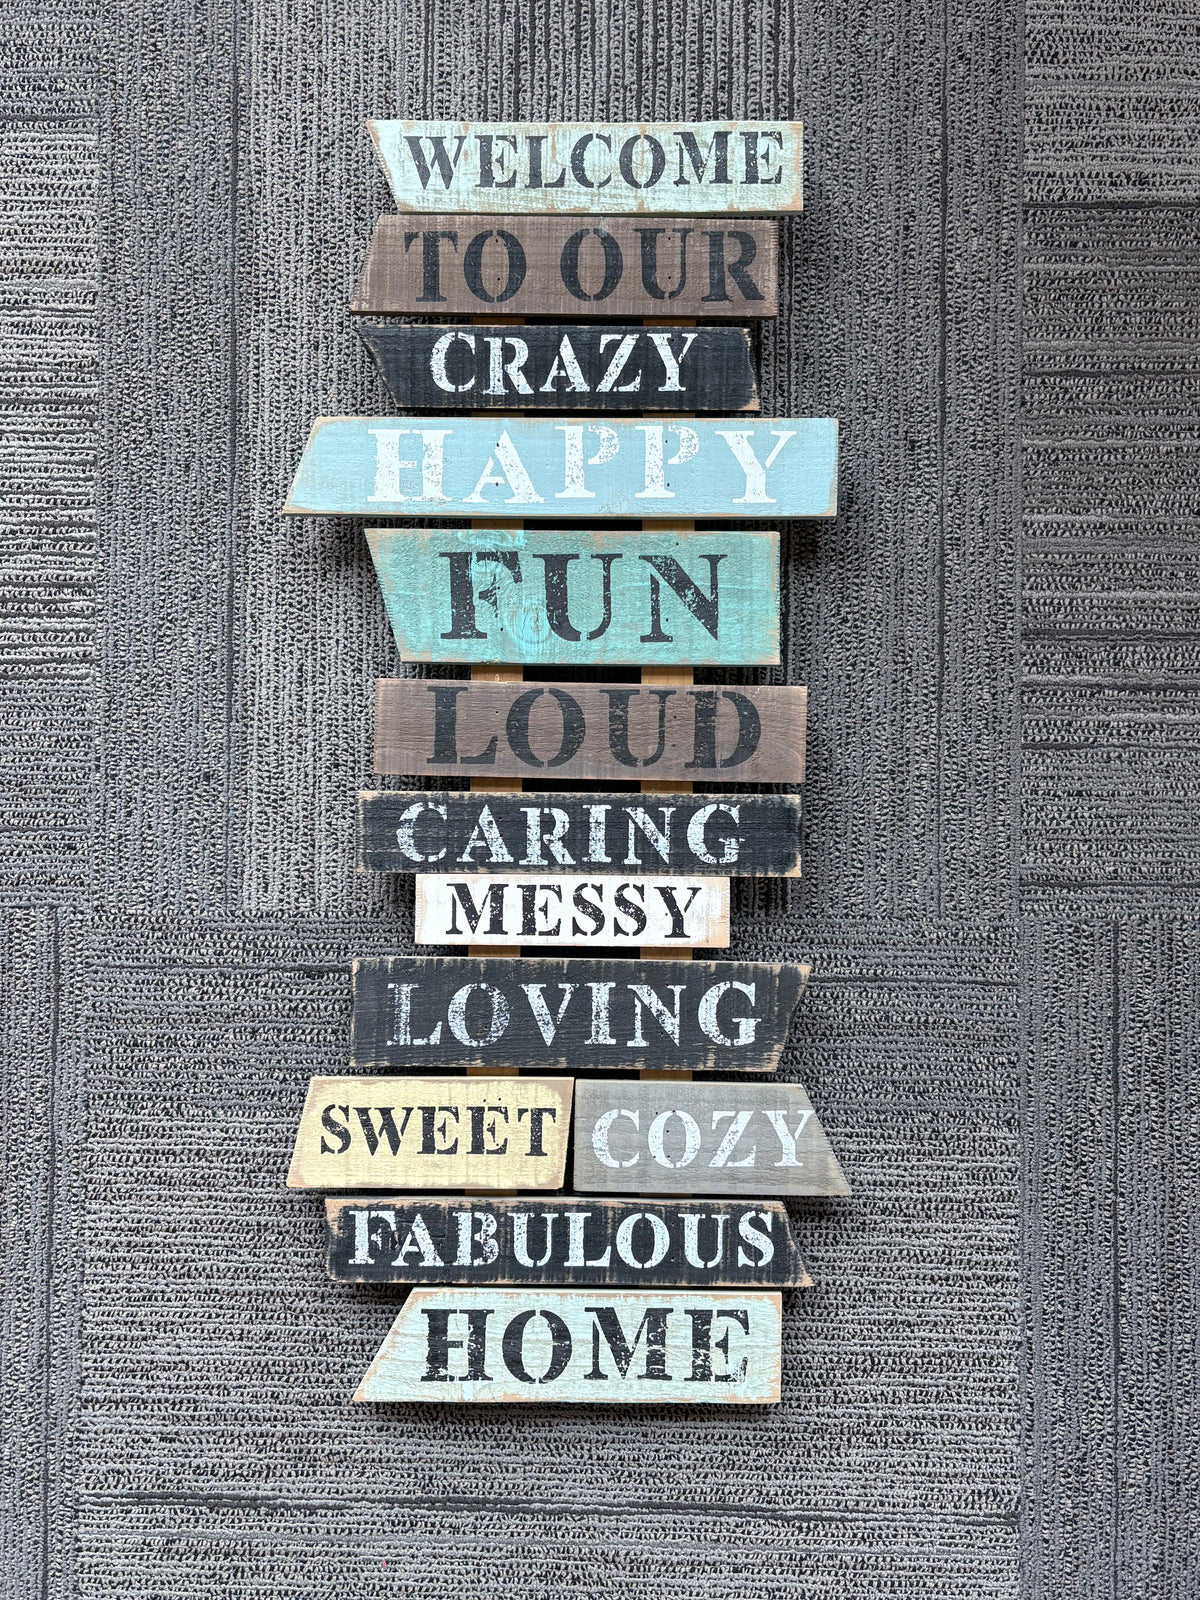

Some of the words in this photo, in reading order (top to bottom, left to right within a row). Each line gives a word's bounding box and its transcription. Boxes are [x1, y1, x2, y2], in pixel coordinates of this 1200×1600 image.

[404, 130, 784, 190] WELCOME
[405, 228, 527, 304] TO
[560, 227, 765, 304] OUR
[429, 331, 699, 395] CRAZY
[366, 424, 797, 505] HAPPY
[439, 550, 728, 643] FUN
[425, 685, 763, 770] LOUD
[395, 801, 745, 866] CARING
[445, 882, 702, 939] MESSY
[386, 980, 761, 1049] LOVING
[320, 1103, 557, 1157] SWEET
[590, 1108, 816, 1169] COZY
[347, 1209, 776, 1269] FABULOUS
[420, 1306, 751, 1385] HOME
